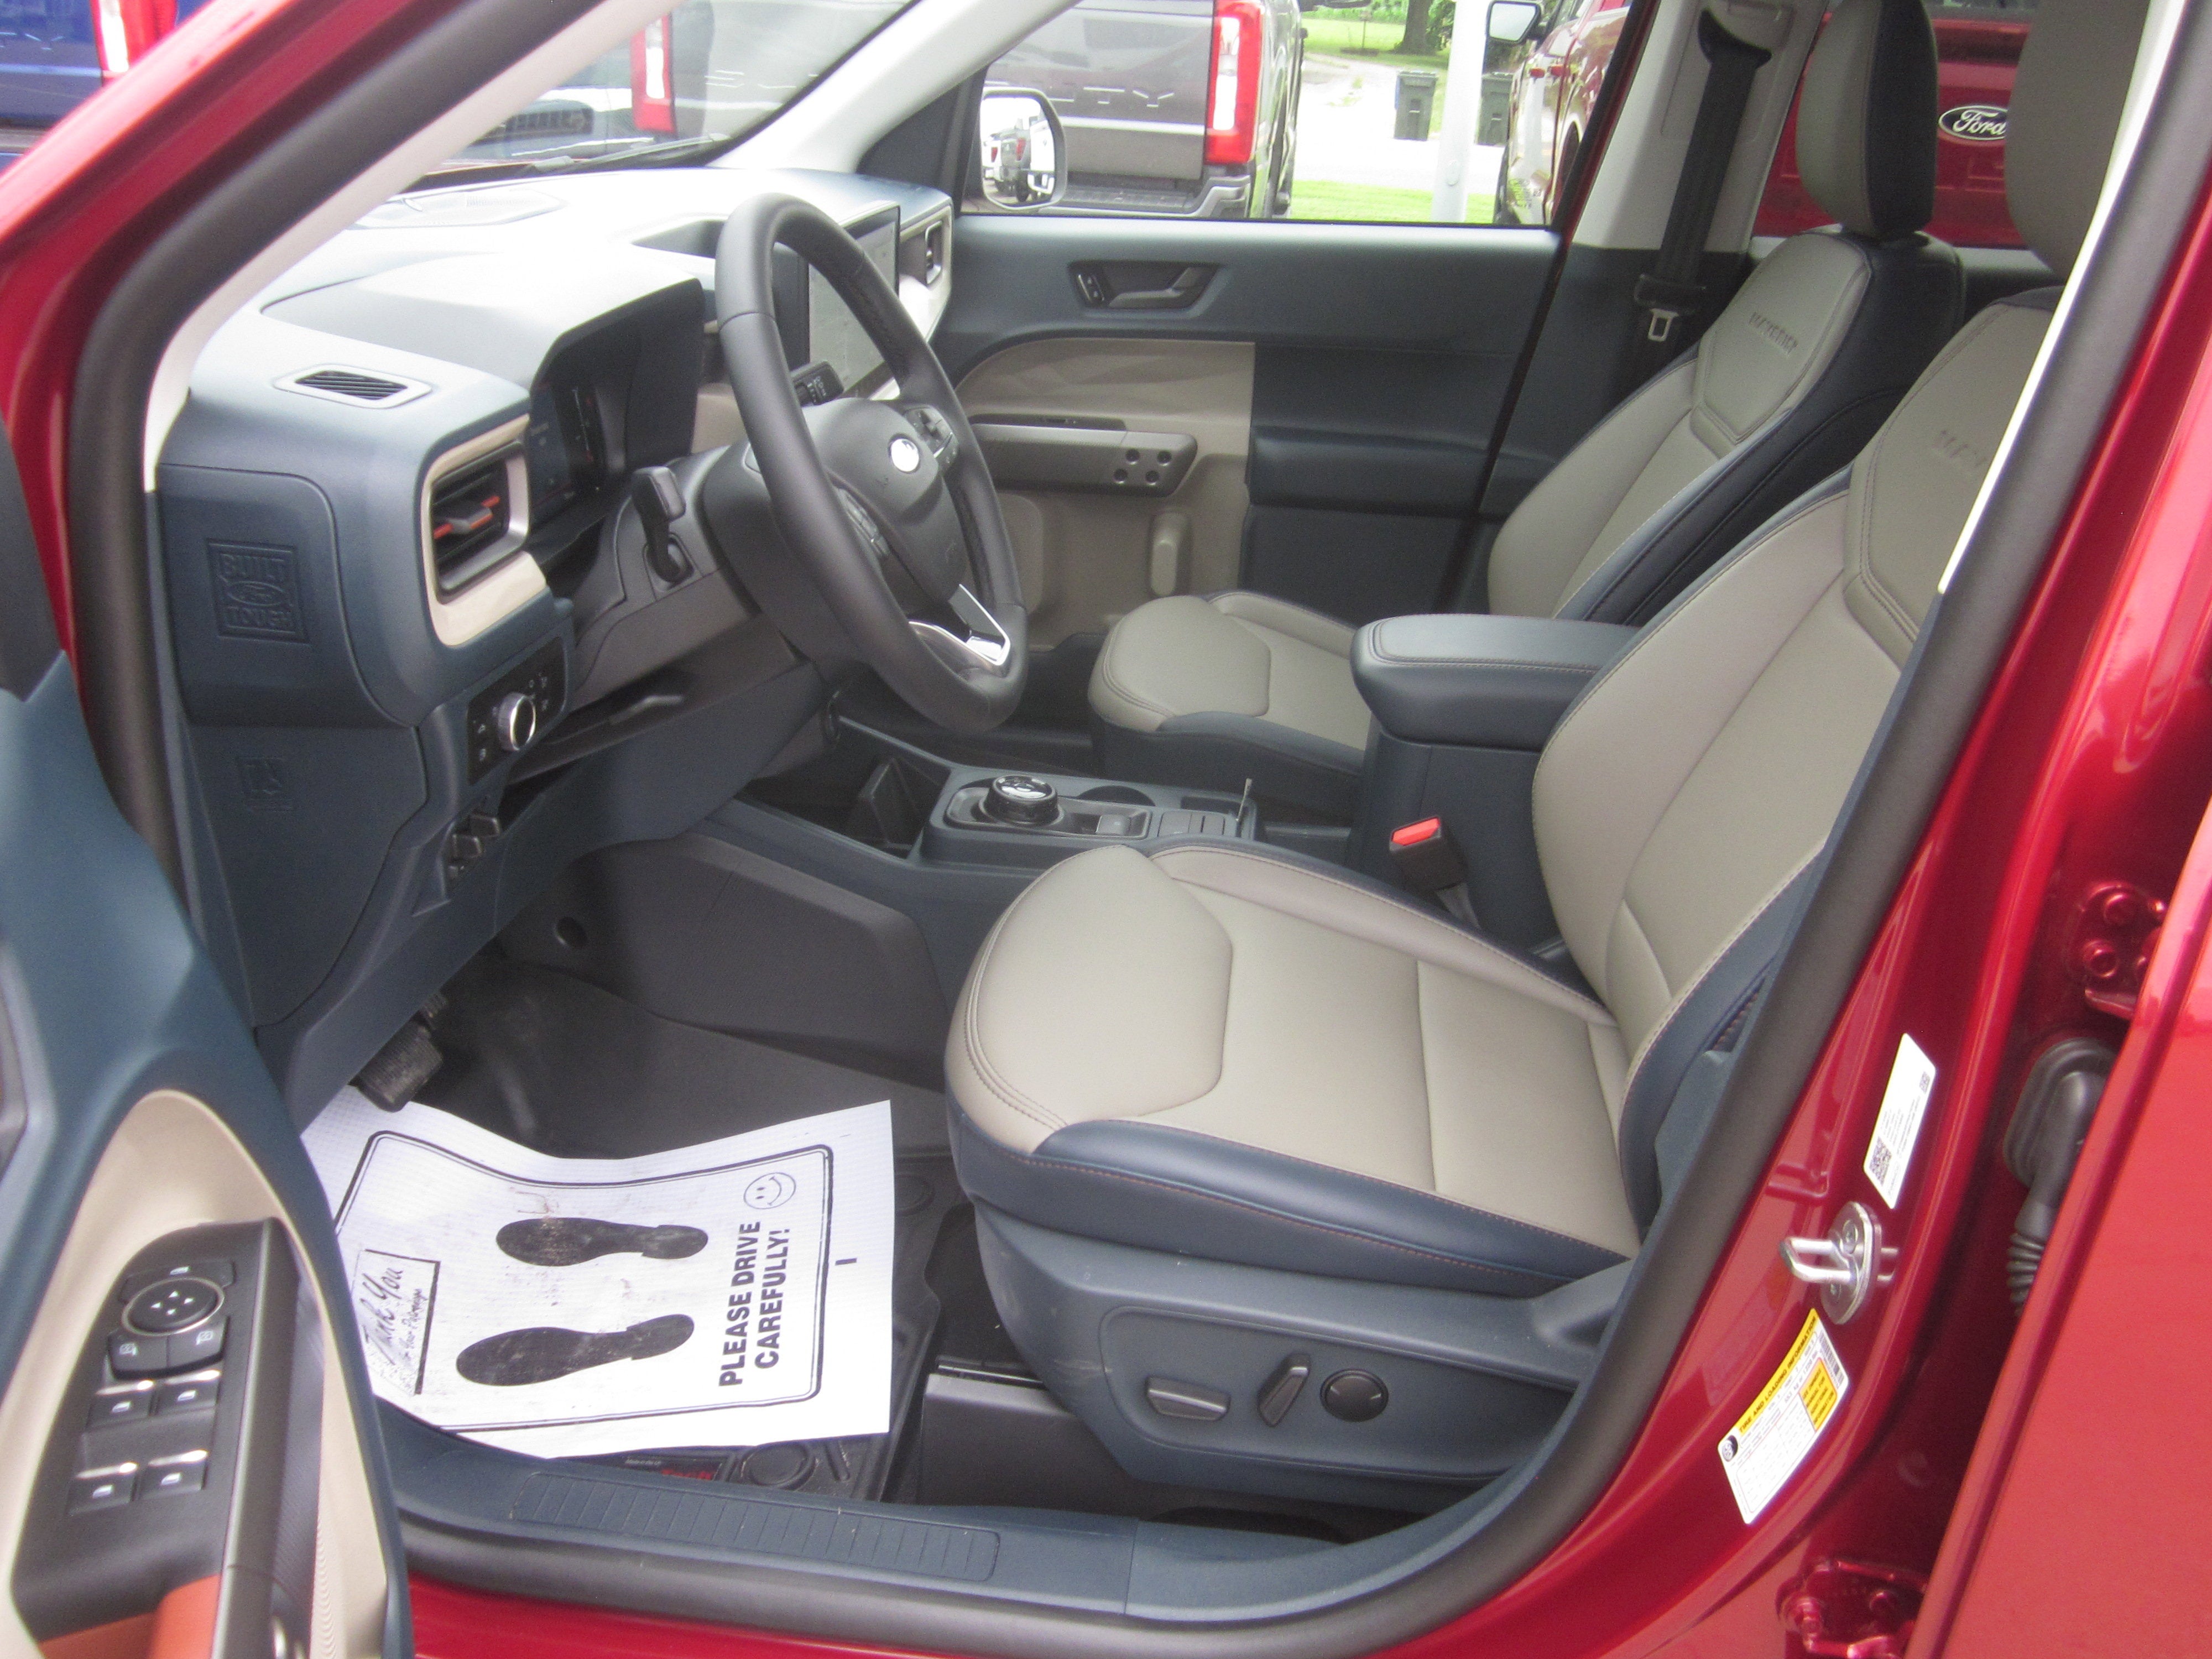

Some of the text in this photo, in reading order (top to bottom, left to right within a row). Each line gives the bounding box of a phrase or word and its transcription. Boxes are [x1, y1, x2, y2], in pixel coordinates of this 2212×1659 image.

[1953, 110, 2007, 135] Ford
[359, 1267, 404, 1366] Tnk You
[718, 1221, 761, 1386] PLEASE DRIVE
[754, 1228, 790, 1369] CAREFULLY!
[1739, 1315, 1816, 1434] TIRE AND LOADING INFORMATION
